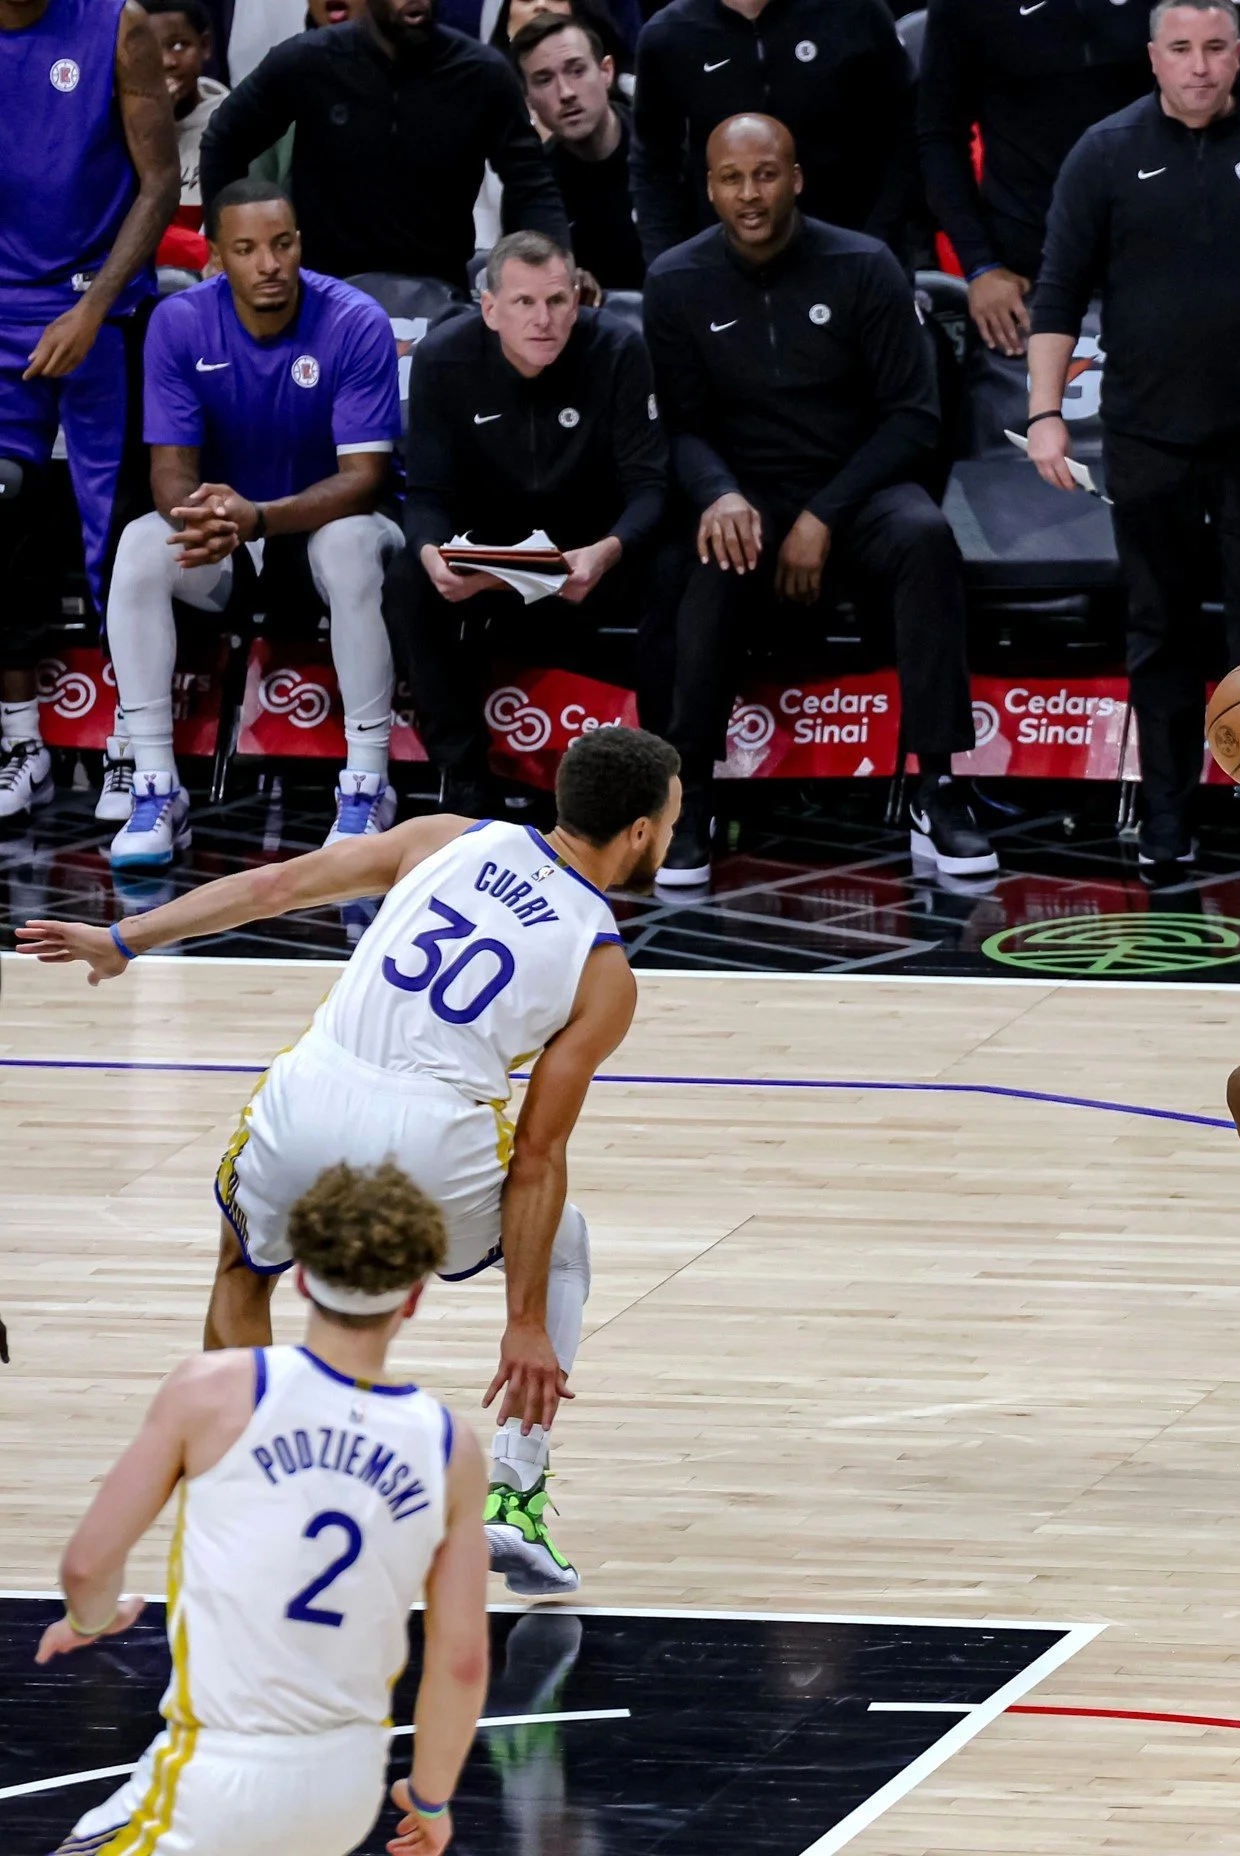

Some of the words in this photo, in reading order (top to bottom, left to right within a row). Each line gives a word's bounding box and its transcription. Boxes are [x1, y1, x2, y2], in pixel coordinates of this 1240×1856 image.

[779, 688, 888, 714] Cedars
[1004, 688, 1114, 716] Cedars
[793, 717, 869, 743] Sinai
[1017, 717, 1094, 744] Sinai
[474, 861, 560, 927] CURRY
[382, 896, 515, 1024] 30
[252, 1427, 430, 1521] PODZIEMSKI
[286, 1511, 362, 1627] 2
